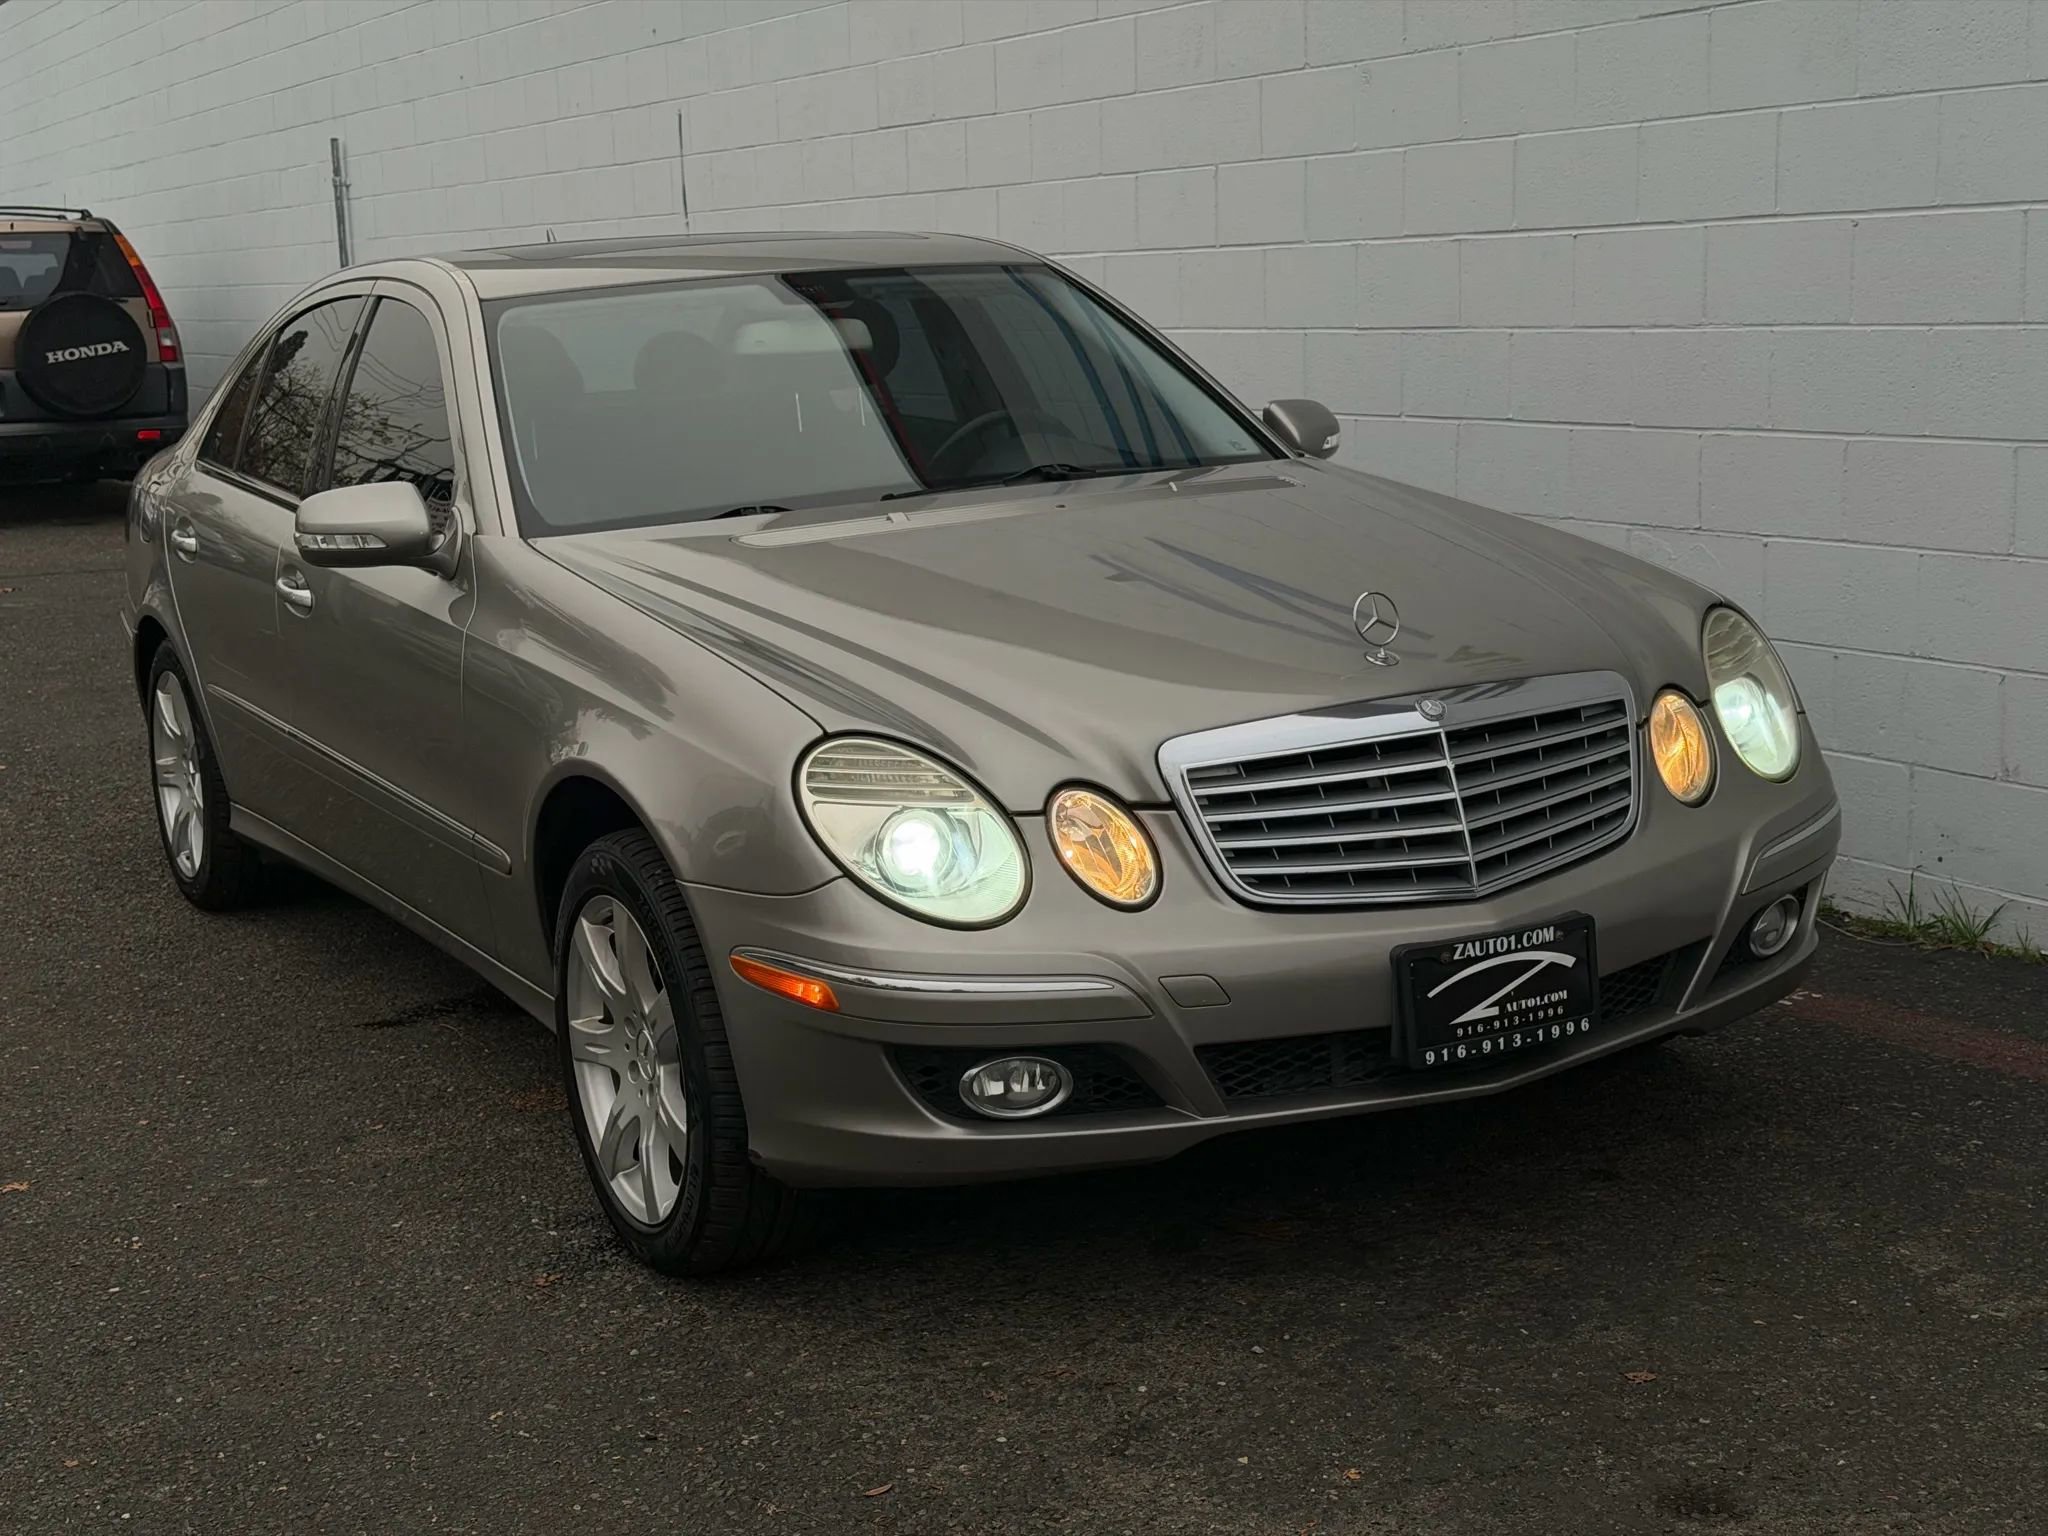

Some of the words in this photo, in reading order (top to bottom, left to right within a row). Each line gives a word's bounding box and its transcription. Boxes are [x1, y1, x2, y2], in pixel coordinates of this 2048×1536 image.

[46, 340, 130, 364] HONDA
[1453, 926, 1555, 960] ZAUTO1.COM
[1504, 990, 1568, 1014] AUTO1.COM
[1456, 1006, 1564, 1037] 916-913-1996
[1425, 1018, 1590, 1065] 916-913-1996
